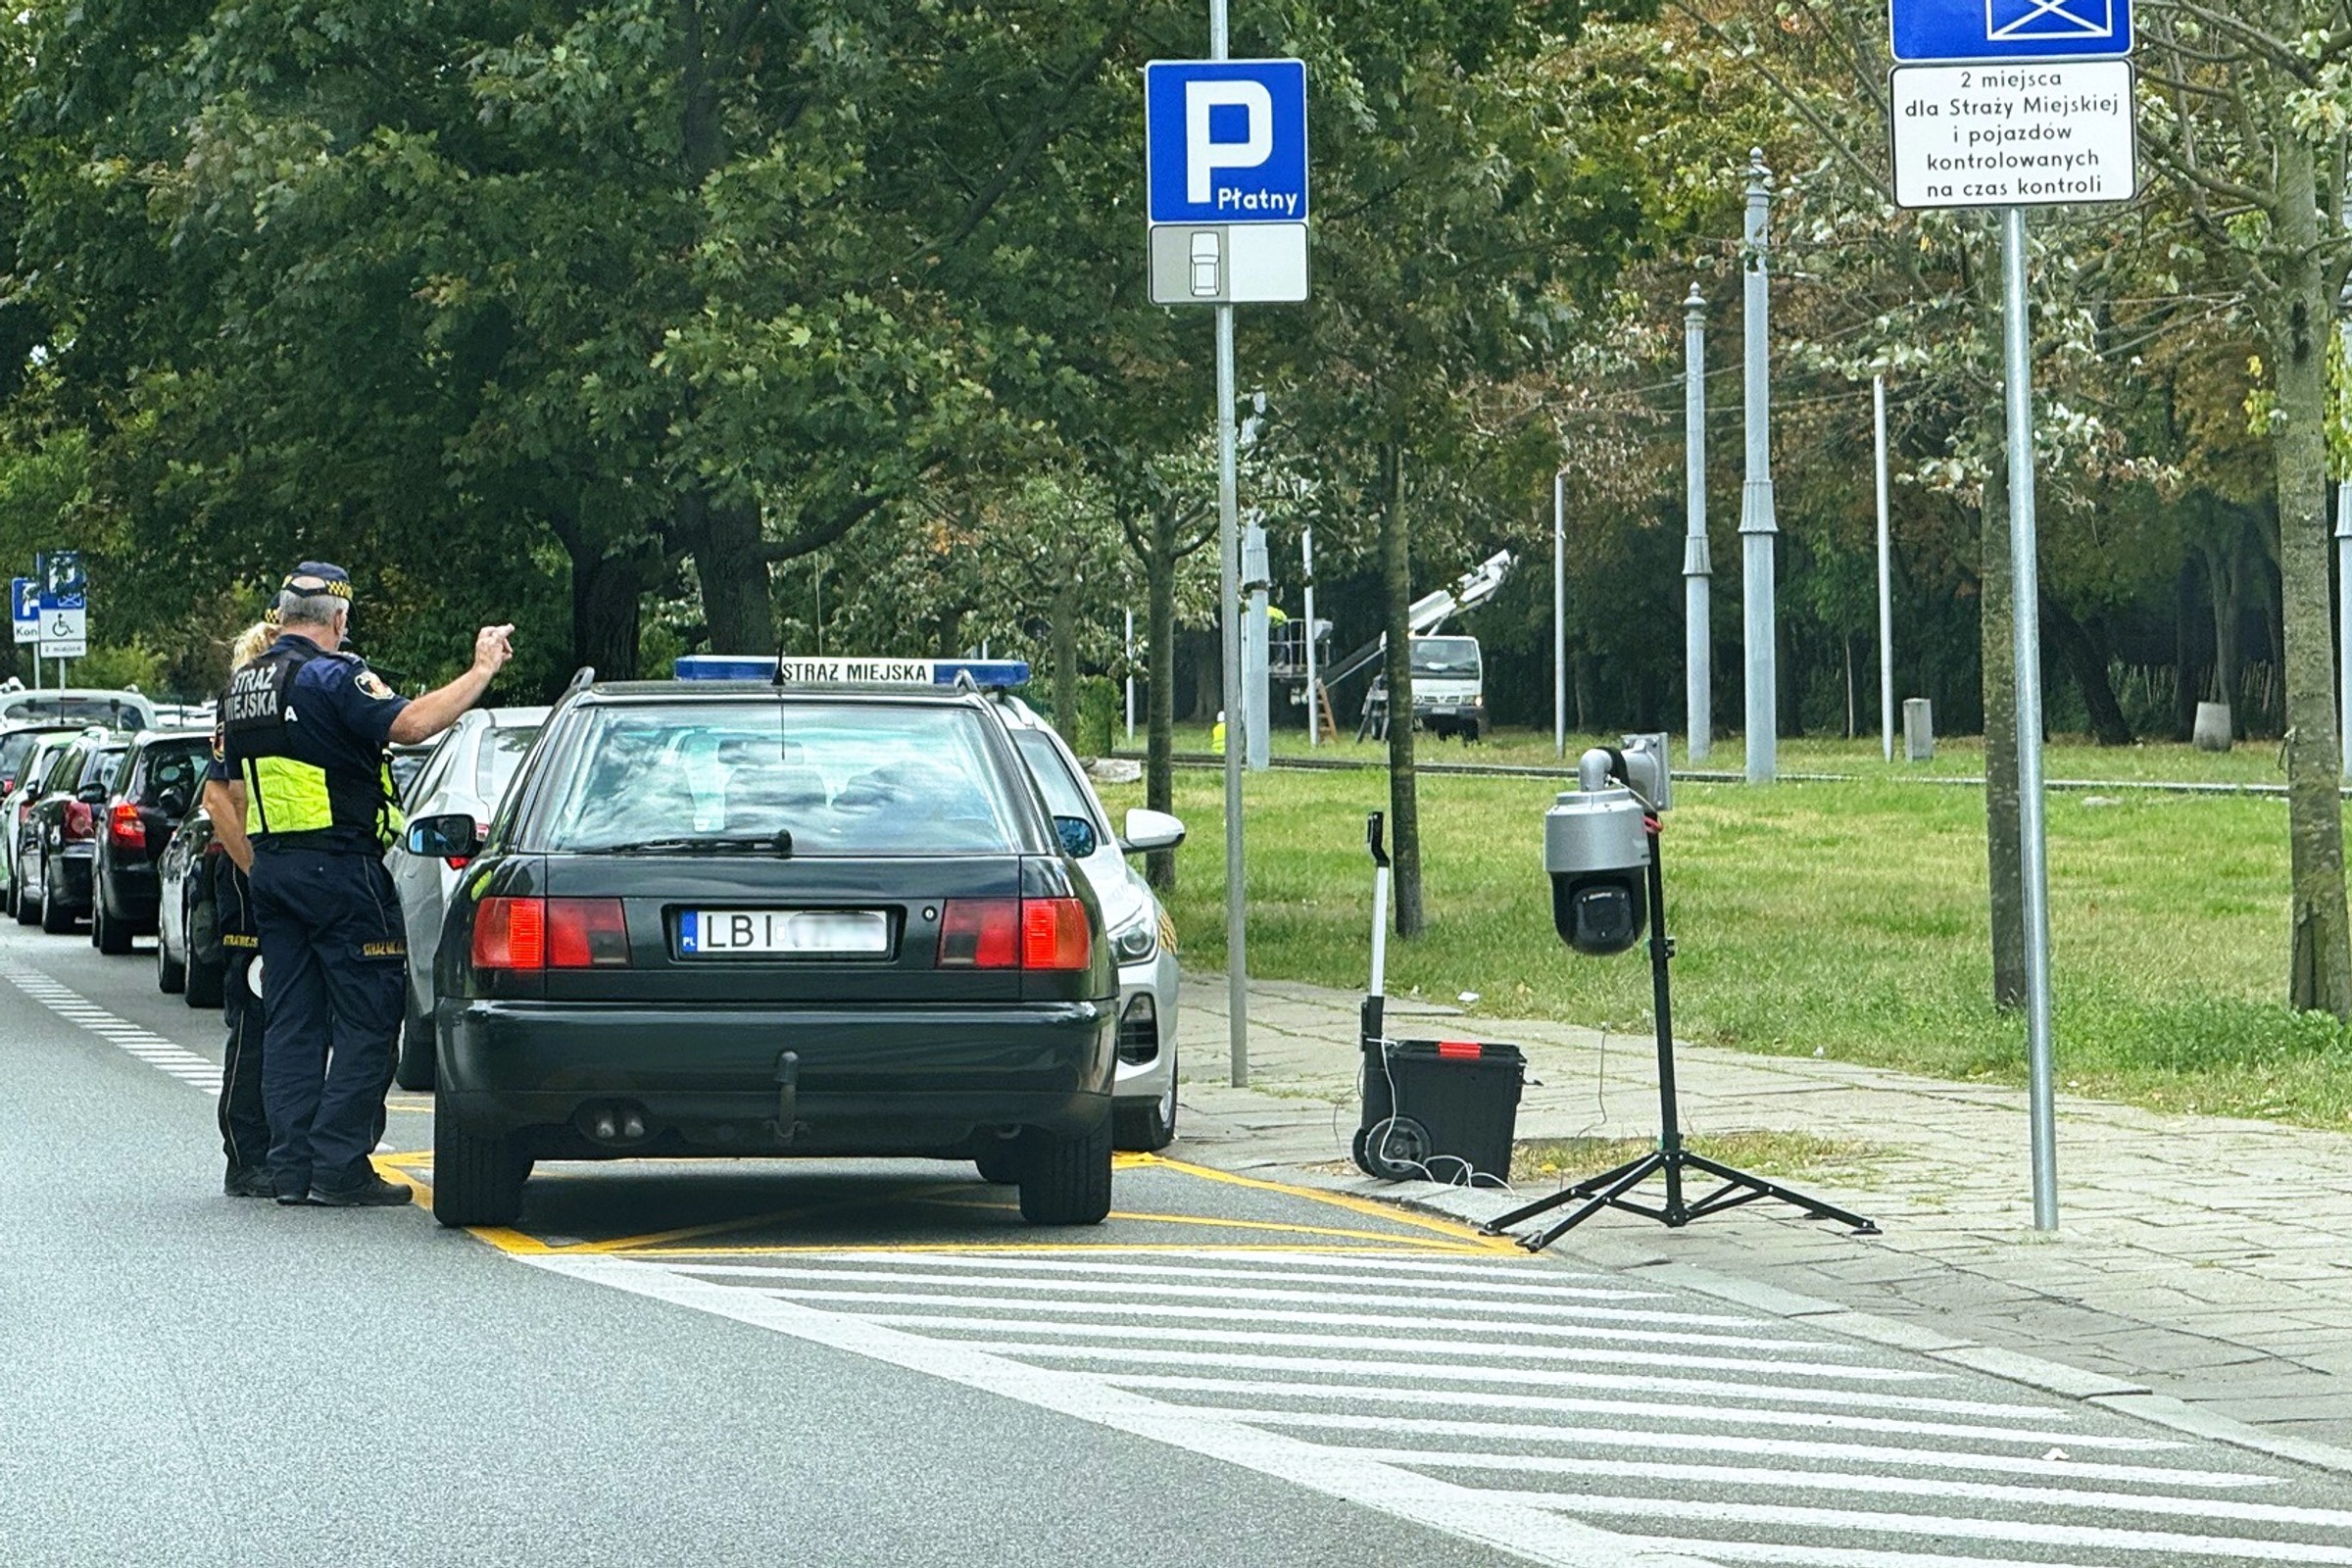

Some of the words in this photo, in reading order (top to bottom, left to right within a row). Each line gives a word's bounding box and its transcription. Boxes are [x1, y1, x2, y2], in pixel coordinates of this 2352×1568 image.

[1960, 72, 1972, 88] 2
[1982, 69, 2063, 92] miejsca
[1904, 100, 1939, 117] dla
[1949, 96, 2014, 119] Straży
[2023, 93, 2119, 117] Miejskiej
[1185, 80, 1273, 203] P
[1953, 125, 1959, 143] i
[1969, 122, 2073, 147] pojazdów
[1926, 148, 2100, 172] kontrolowanych
[1927, 183, 1953, 197] na
[1963, 182, 2008, 197] czas
[2018, 175, 2101, 195] kontroli
[1217, 187, 1298, 216] Płatny
[16, 627, 38, 636] Kon
[231, 662, 278, 695] STRAŻ
[847, 662, 927, 681] MIEJSKA
[682, 936, 697, 947] PL
